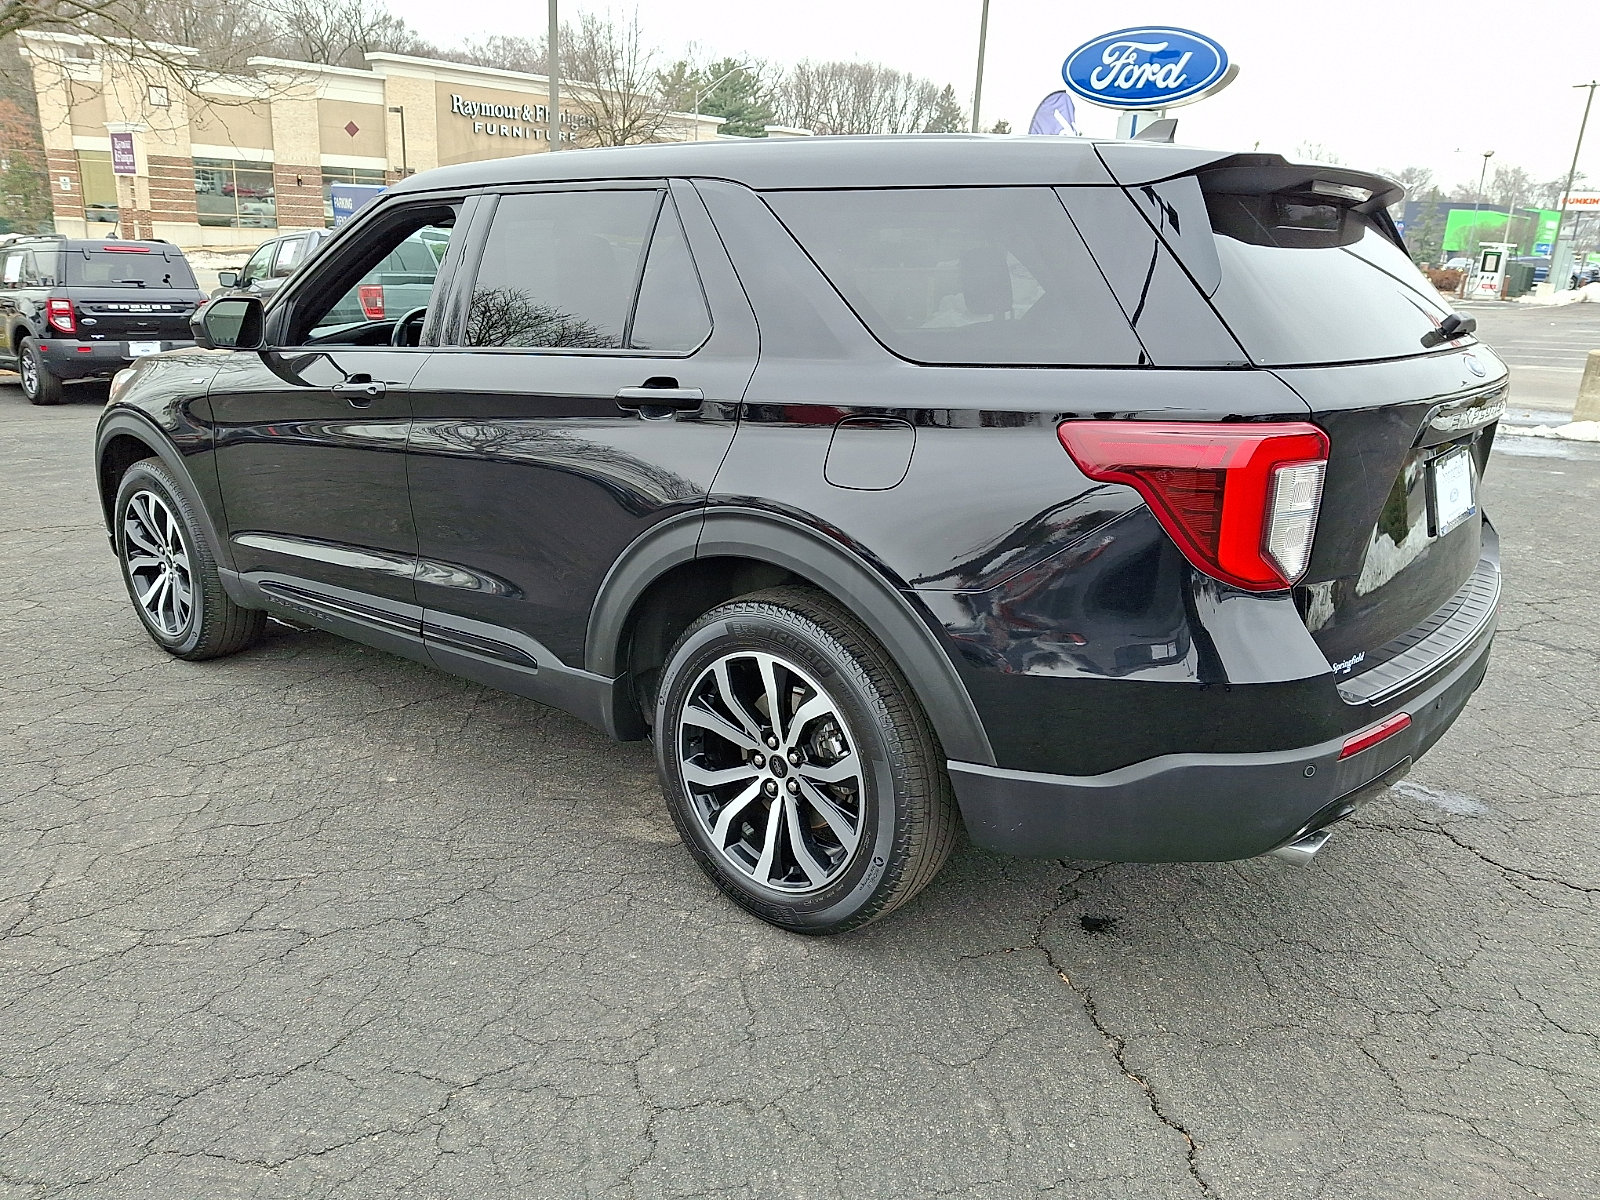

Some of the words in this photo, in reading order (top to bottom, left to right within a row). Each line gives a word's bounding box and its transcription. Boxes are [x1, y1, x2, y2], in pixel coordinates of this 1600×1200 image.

[1090, 41, 1193, 90] Ford
[451, 94, 521, 119] Raymour
[521, 104, 534, 122] &
[534, 104, 596, 130] Flnigan
[1332, 651, 1366, 674] Springfield
